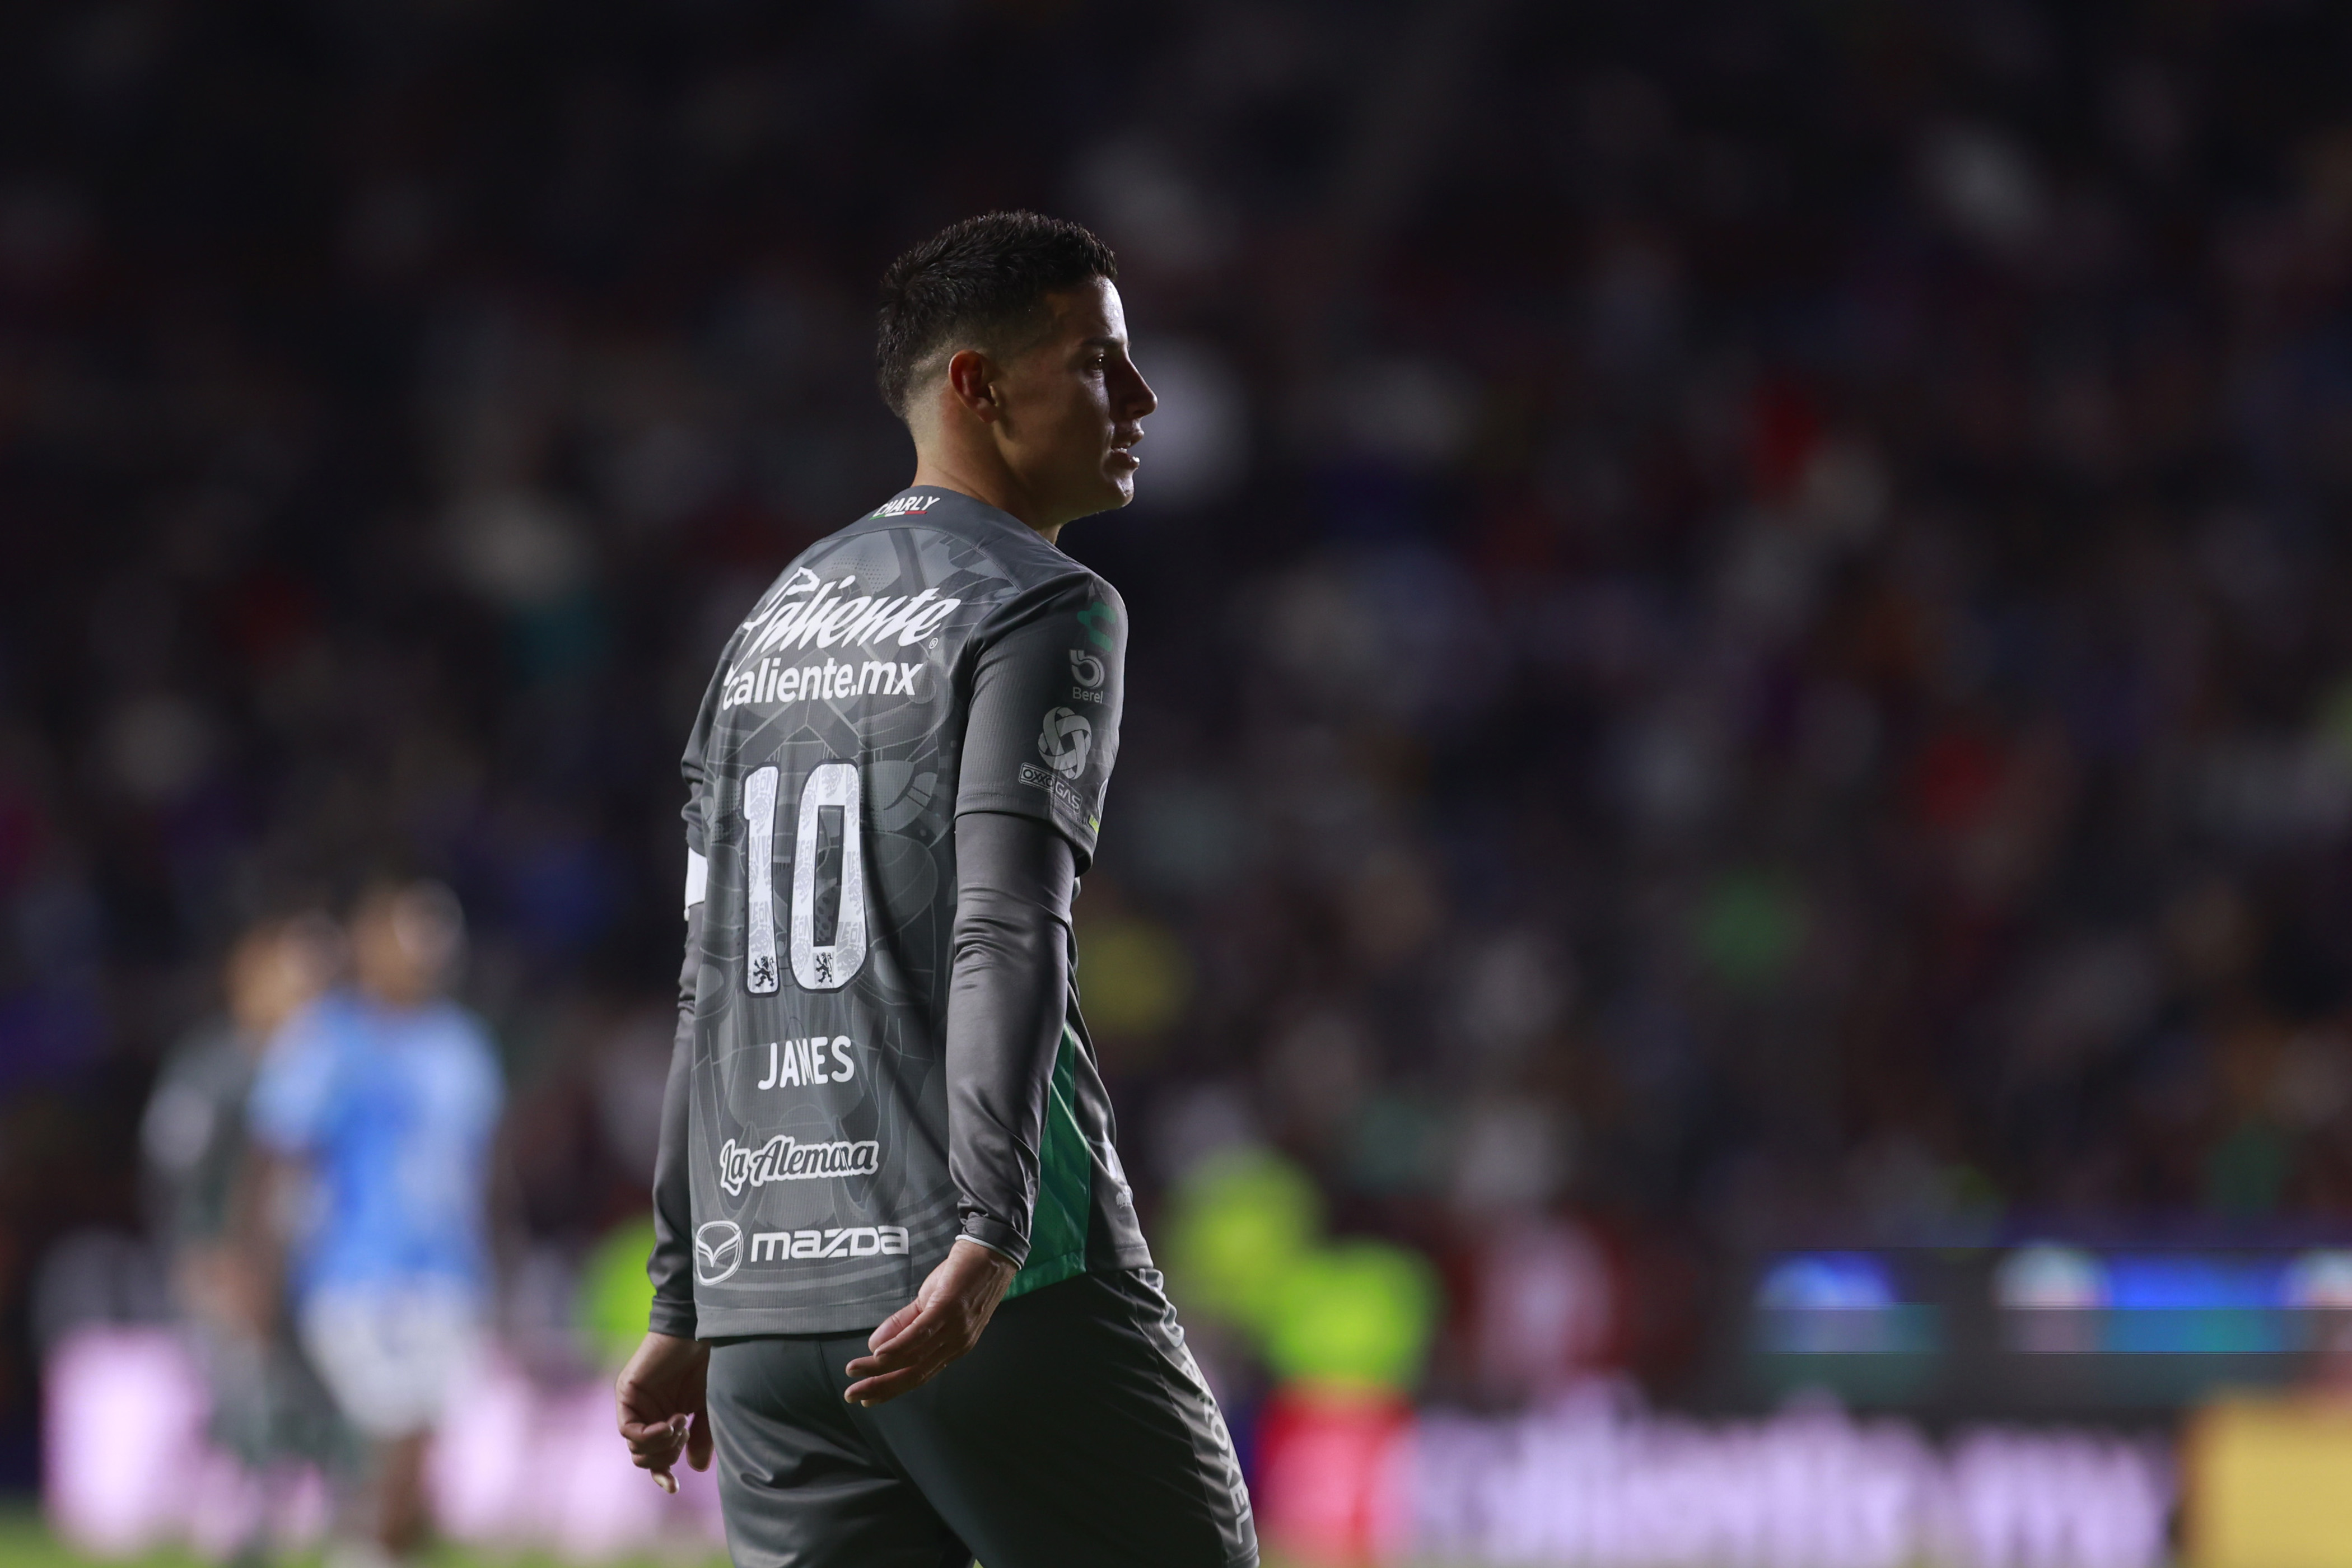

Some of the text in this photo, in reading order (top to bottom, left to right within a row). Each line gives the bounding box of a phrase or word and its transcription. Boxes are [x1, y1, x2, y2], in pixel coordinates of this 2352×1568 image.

[872, 496, 941, 517] CHARLY
[723, 657, 923, 711] caliente.mx
[1072, 687, 1103, 703] Berel
[1023, 769, 1081, 810] OXXO GAS
[743, 763, 868, 994] 10
[721, 1141, 749, 1194] La
[751, 1225, 909, 1262] mazda
